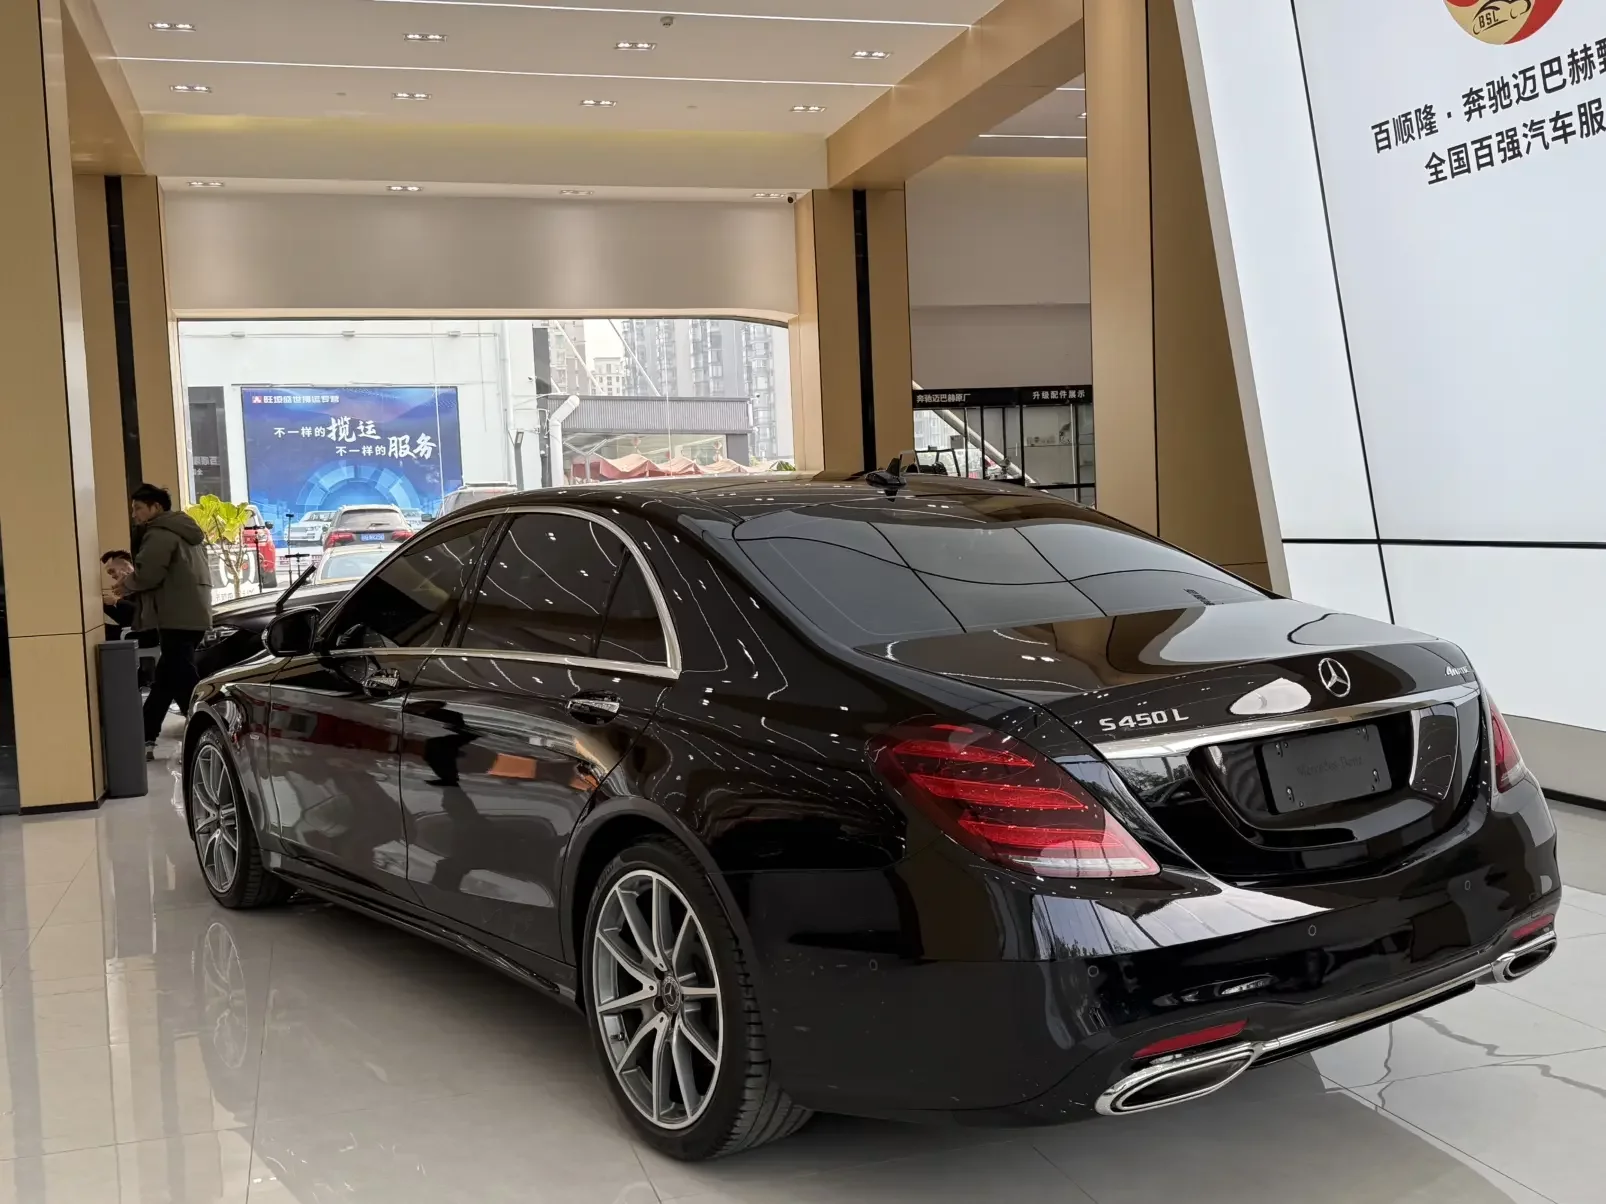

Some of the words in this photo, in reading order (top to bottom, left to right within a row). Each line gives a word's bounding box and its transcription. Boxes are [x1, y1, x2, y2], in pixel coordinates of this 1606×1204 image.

[1478, 11, 1500, 28] BSL
[1424, 97, 1606, 185] 全国百强汽车服
[1032, 389, 1086, 400] 升级配件展示
